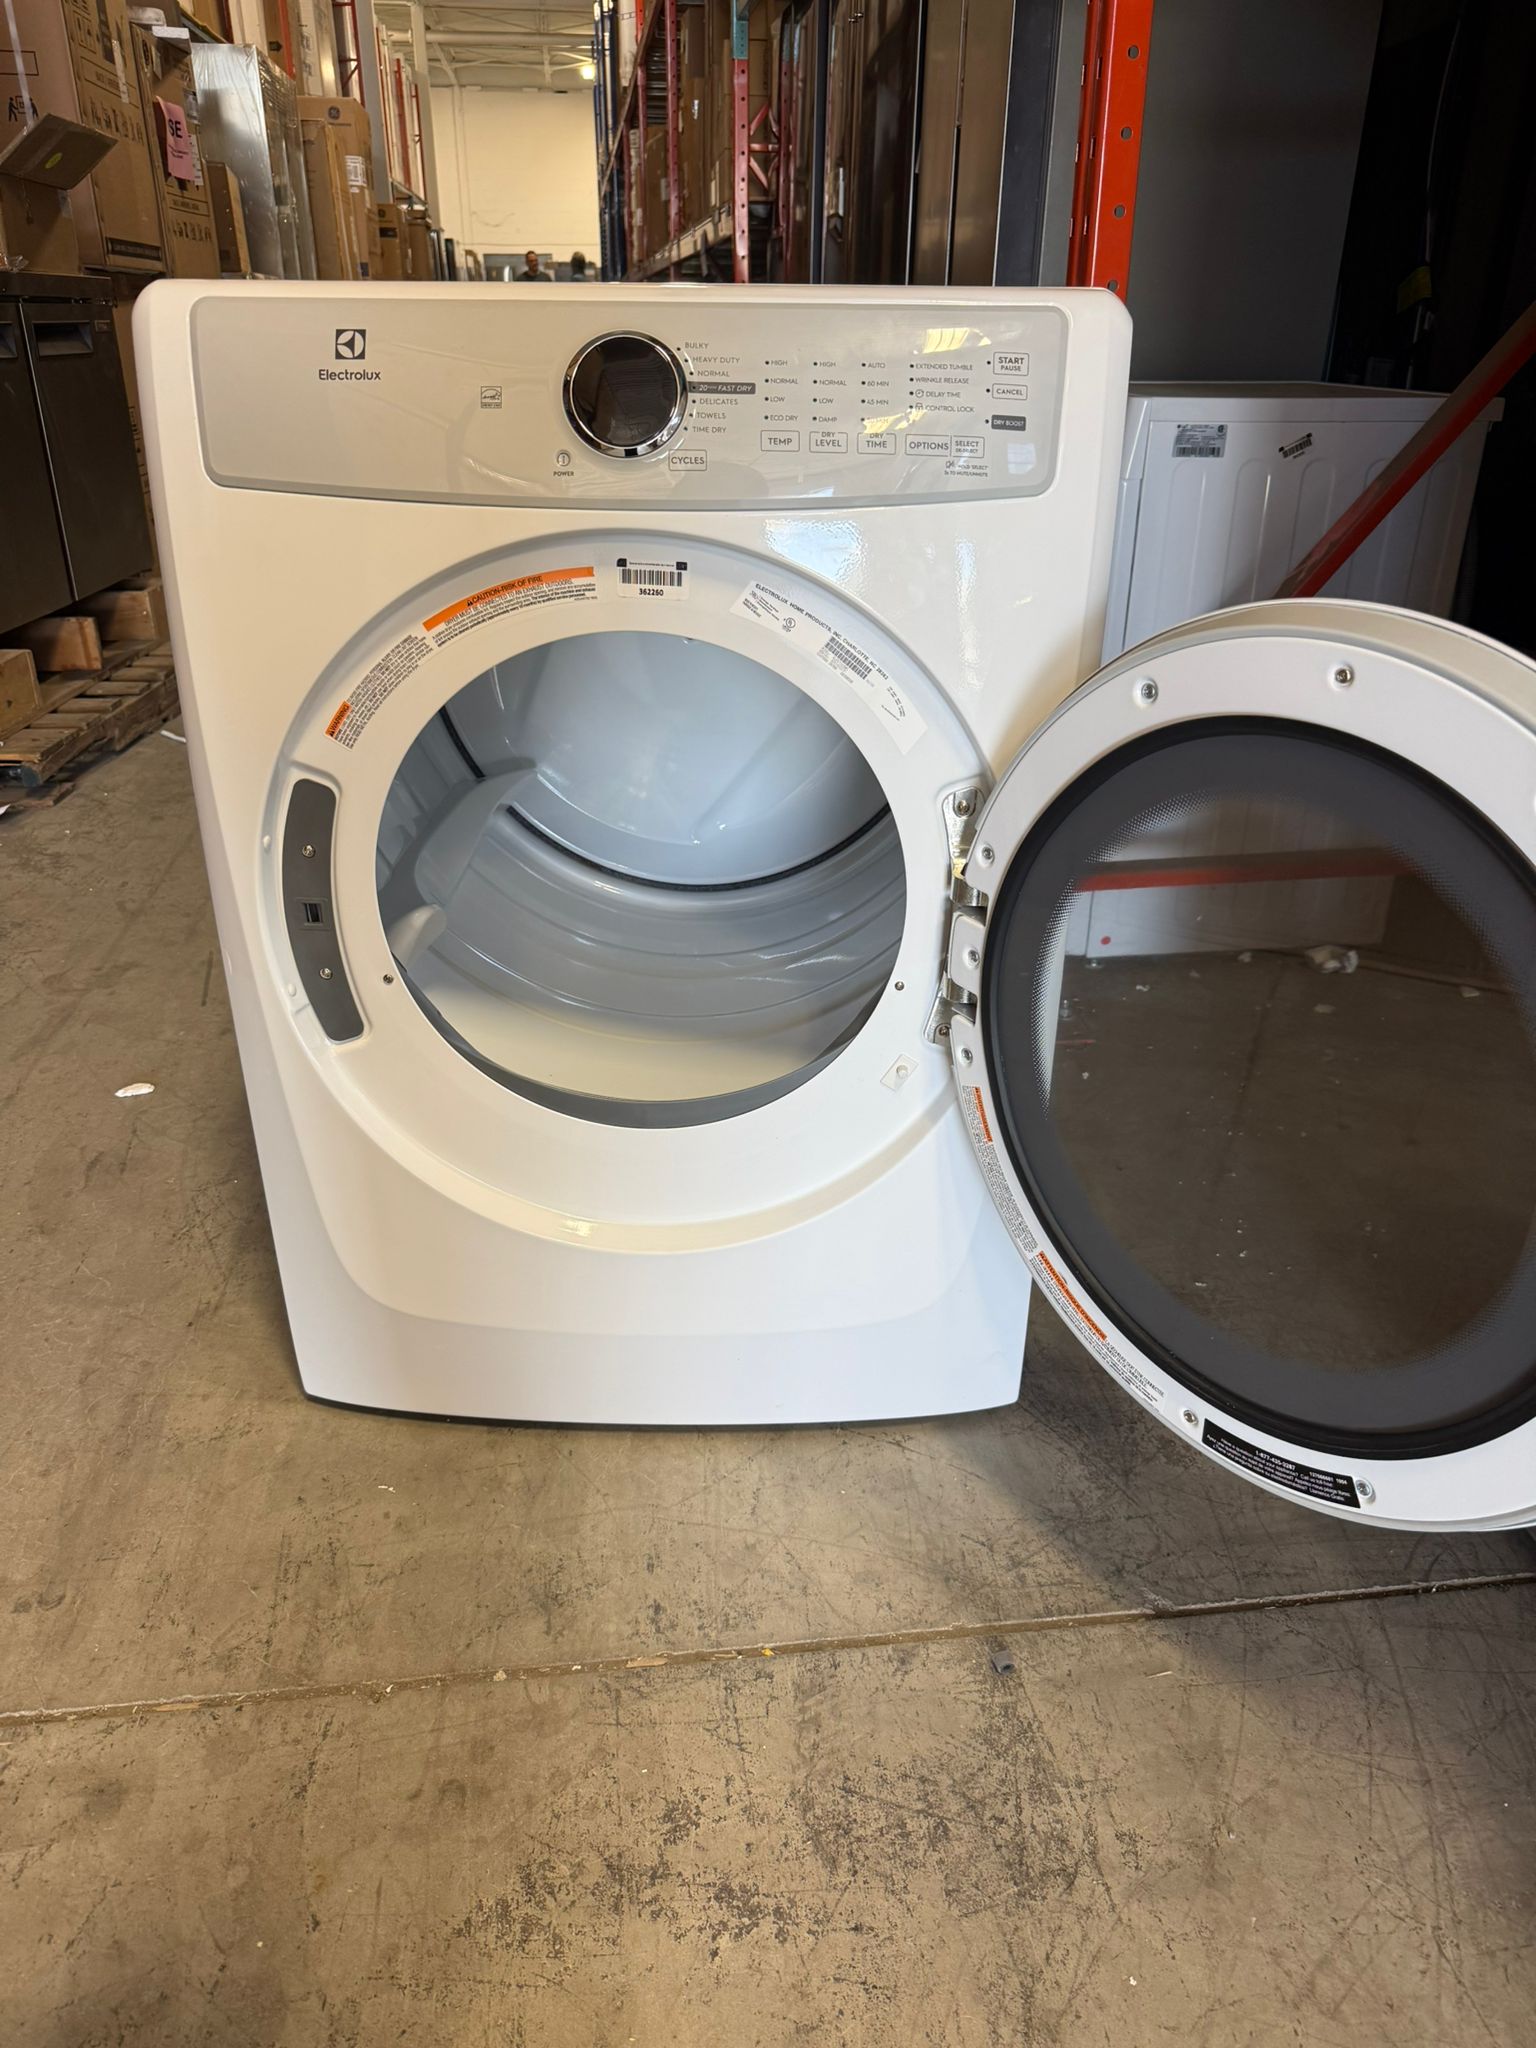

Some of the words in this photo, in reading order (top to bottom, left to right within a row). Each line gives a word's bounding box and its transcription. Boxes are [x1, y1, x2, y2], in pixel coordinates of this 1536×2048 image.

[693, 356, 719, 364] HEAVY
[998, 356, 1025, 365] START
[318, 369, 381, 381] Electrolux
[996, 388, 1024, 396] CANCEL
[711, 426, 727, 434] DRY
[767, 437, 793, 446] TEMP
[815, 439, 842, 448] LEVEL
[866, 440, 888, 449] TIME
[909, 441, 950, 451] OPTIONS
[955, 440, 980, 448] SELECT
[671, 456, 705, 465] CYCLES
[516, 578, 526, 587] OF
[526, 575, 544, 585] FIRE
[639, 588, 664, 596] 362260
[755, 583, 789, 605] ELECTROLUX
[789, 602, 805, 615] HOME
